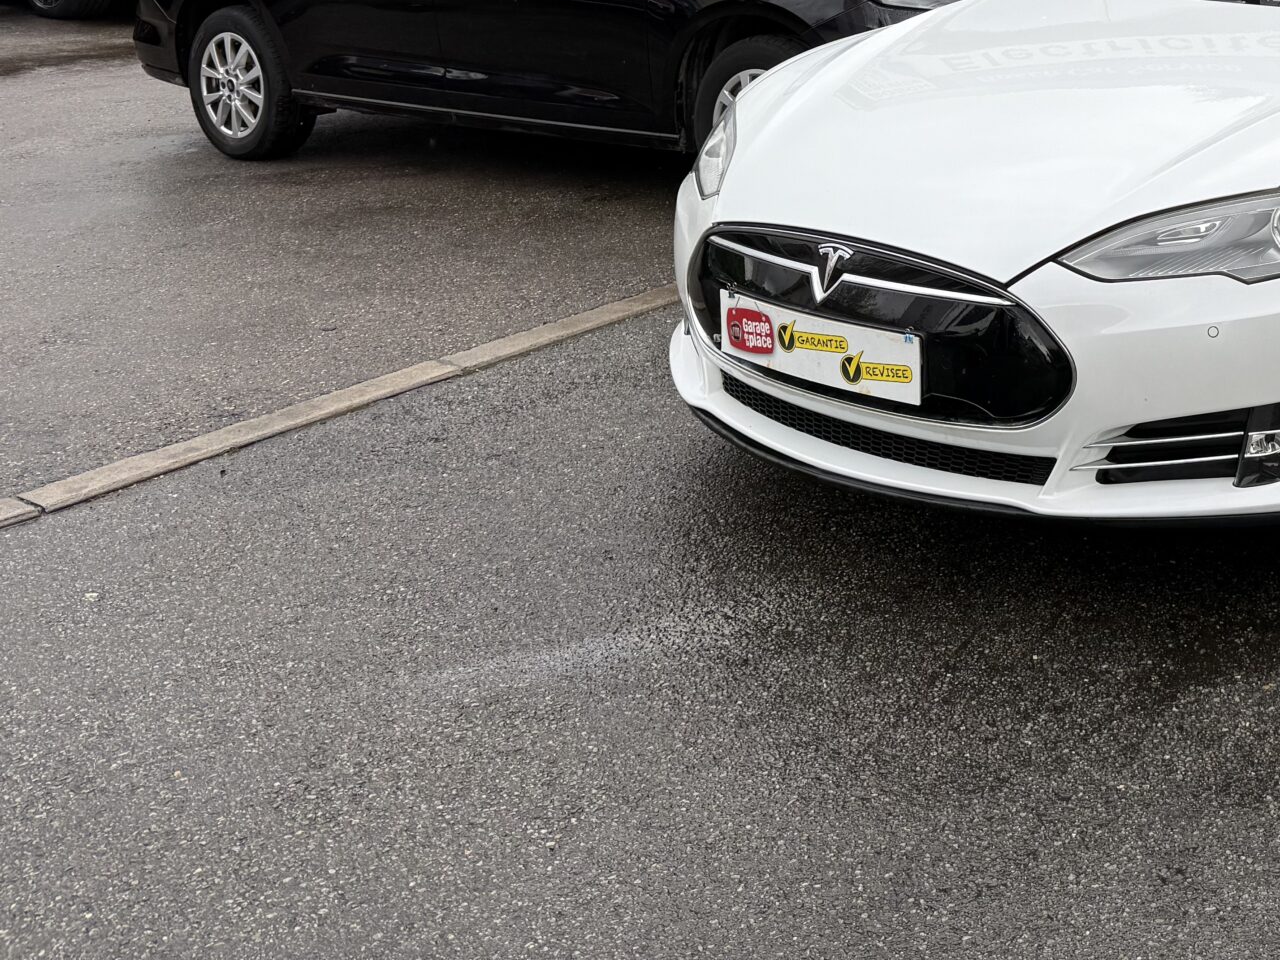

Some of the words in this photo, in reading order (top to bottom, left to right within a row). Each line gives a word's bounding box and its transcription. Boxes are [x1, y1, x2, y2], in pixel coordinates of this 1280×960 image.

[742, 318, 771, 336] Garage
[749, 333, 773, 349] place
[796, 335, 846, 350] GARANTIE
[864, 365, 909, 379] REVISEE
